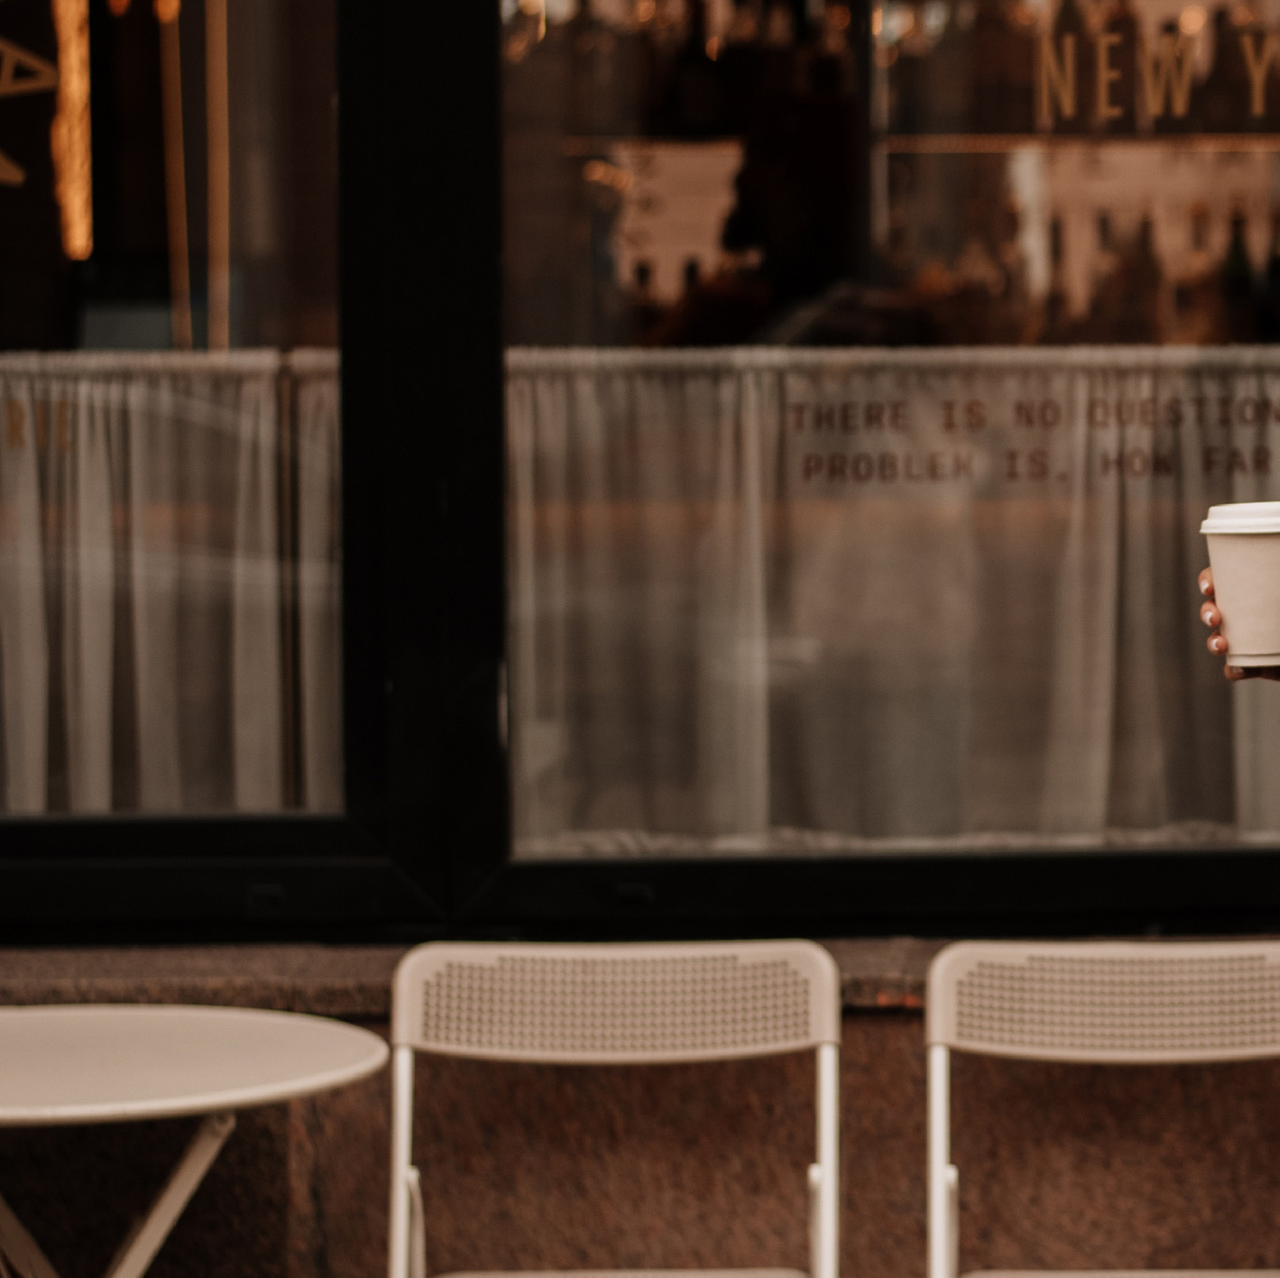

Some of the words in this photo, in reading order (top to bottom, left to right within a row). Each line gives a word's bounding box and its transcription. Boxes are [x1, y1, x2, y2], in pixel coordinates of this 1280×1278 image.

[1038, 31, 1196, 118] NEW
[788, 399, 908, 434] THERE
[941, 398, 989, 434] IS
[1013, 397, 1064, 432] NO
[801, 450, 975, 486] PROBLEM
[1202, 443, 1274, 478] FAR
